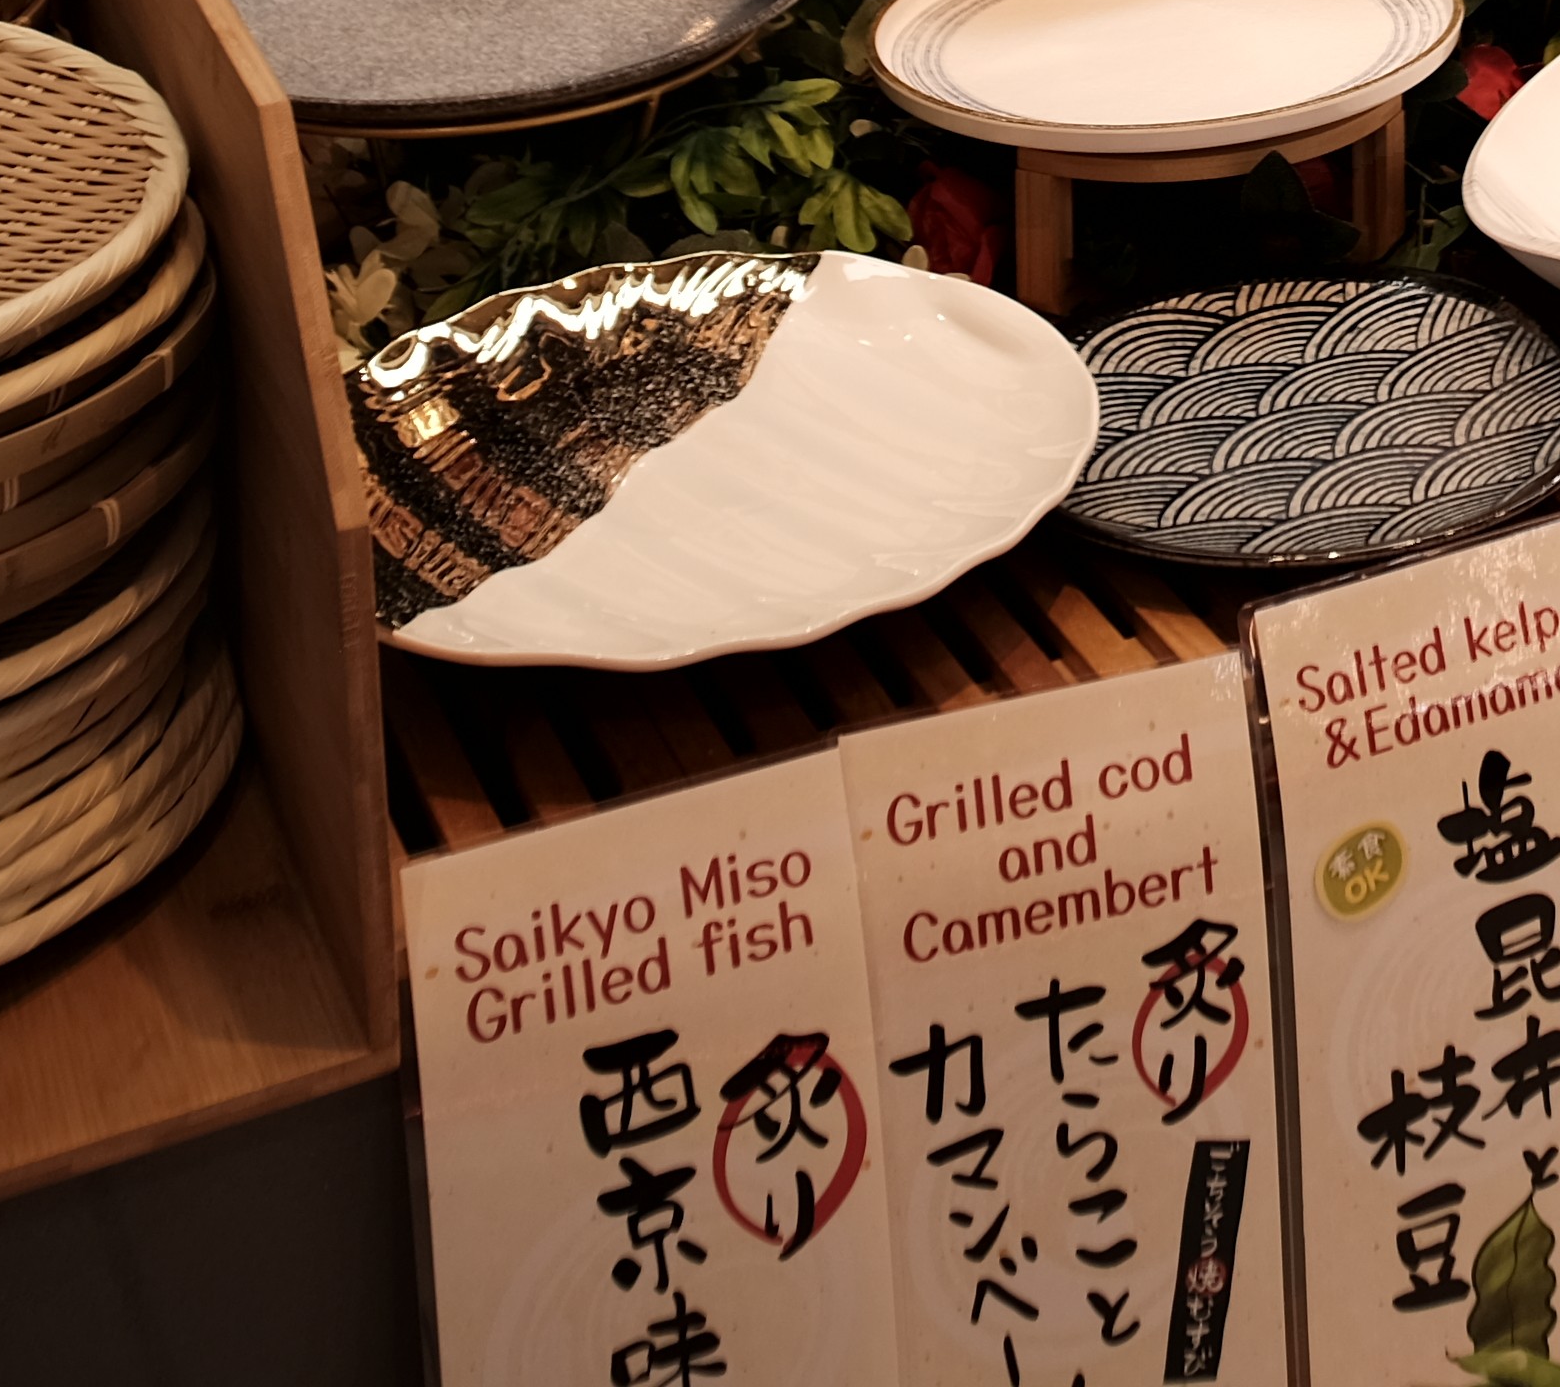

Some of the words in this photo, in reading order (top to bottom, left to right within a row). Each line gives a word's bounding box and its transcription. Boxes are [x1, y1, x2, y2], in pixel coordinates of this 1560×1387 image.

[1295, 625, 1444, 715] Salted
[1465, 601, 1560, 660] kelp
[885, 761, 1073, 847] Grilled
[1098, 734, 1193, 800] cod
[998, 818, 1098, 886] and
[455, 896, 655, 983] Saikyo
[680, 850, 812, 918] Miso
[902, 847, 1219, 964] Camembert
[1343, 863, 1390, 905] OK
[465, 939, 671, 1044] Grilled
[695, 904, 814, 978] fish
[1142, 919, 1244, 1124] 炙り
[720, 1034, 840, 1261] 炙り
[1358, 1044, 1486, 1312] 枝豆
